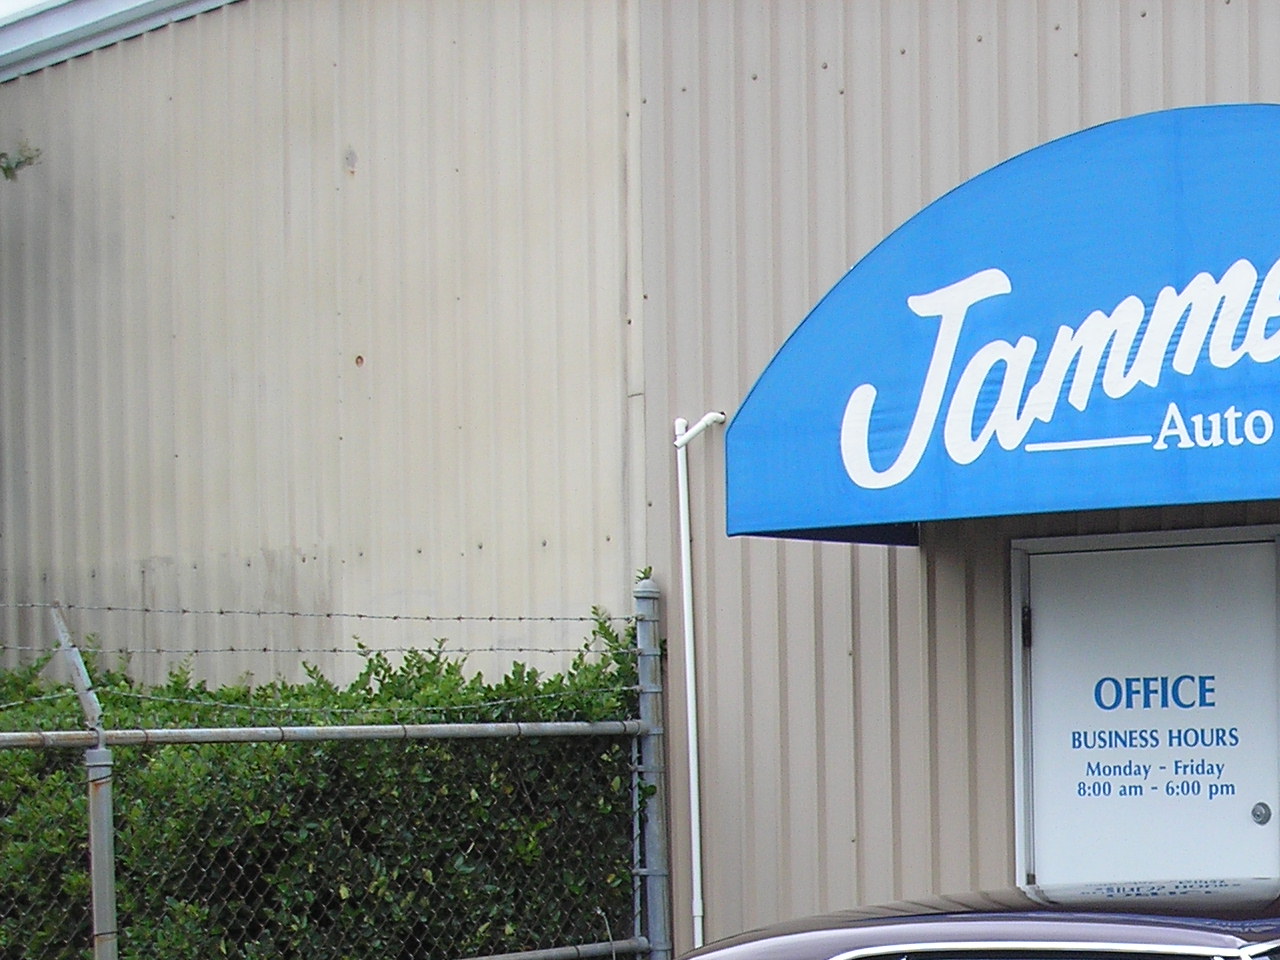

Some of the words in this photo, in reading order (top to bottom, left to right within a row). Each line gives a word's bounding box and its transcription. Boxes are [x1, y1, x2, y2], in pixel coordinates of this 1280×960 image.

[1152, 402, 1274, 450] Auto
[1093, 674, 1216, 711] OFFICE
[1071, 729, 1160, 750] BUSINESS
[1168, 727, 1240, 748] HOURS
[1086, 759, 1152, 781] Monday
[1174, 758, 1225, 780] Friday
[1077, 781, 1112, 797] 8:00
[1118, 784, 1143, 797] am
[1165, 780, 1201, 796] 6:00
[1208, 783, 1236, 801] pm
